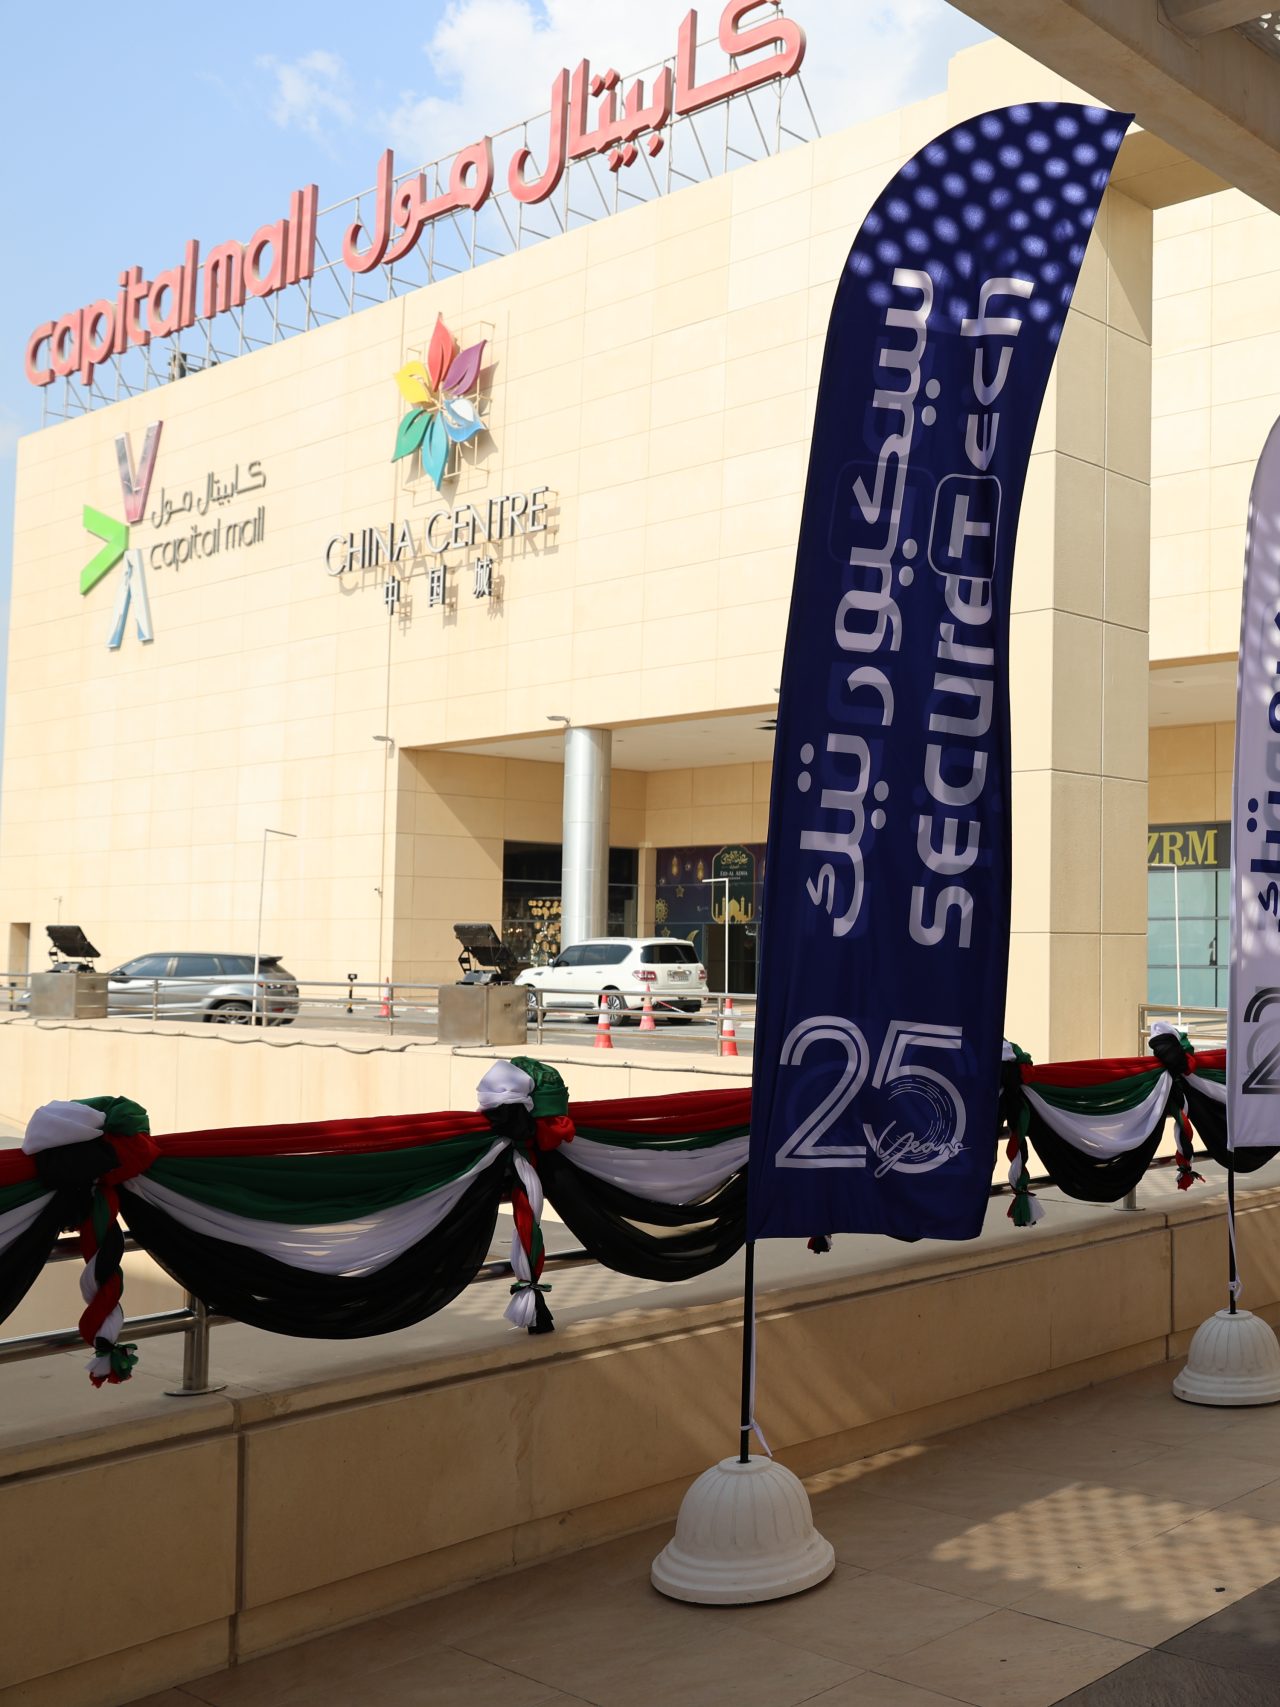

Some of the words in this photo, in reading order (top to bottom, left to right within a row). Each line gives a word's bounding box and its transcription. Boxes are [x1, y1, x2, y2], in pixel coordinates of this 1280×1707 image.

[508, 0, 807, 204] كابيتال
[342, 135, 495, 274] مول
[24, 239, 200, 387] capital
[204, 183, 319, 320] mall
[150, 518, 221, 572] capital
[225, 505, 265, 551] mall
[151, 487, 194, 529] مول
[196, 461, 267, 516] كابيتال
[324, 519, 418, 576] CHINA
[425, 486, 549, 554] CENTRE
[775, 1015, 967, 1174] 25
